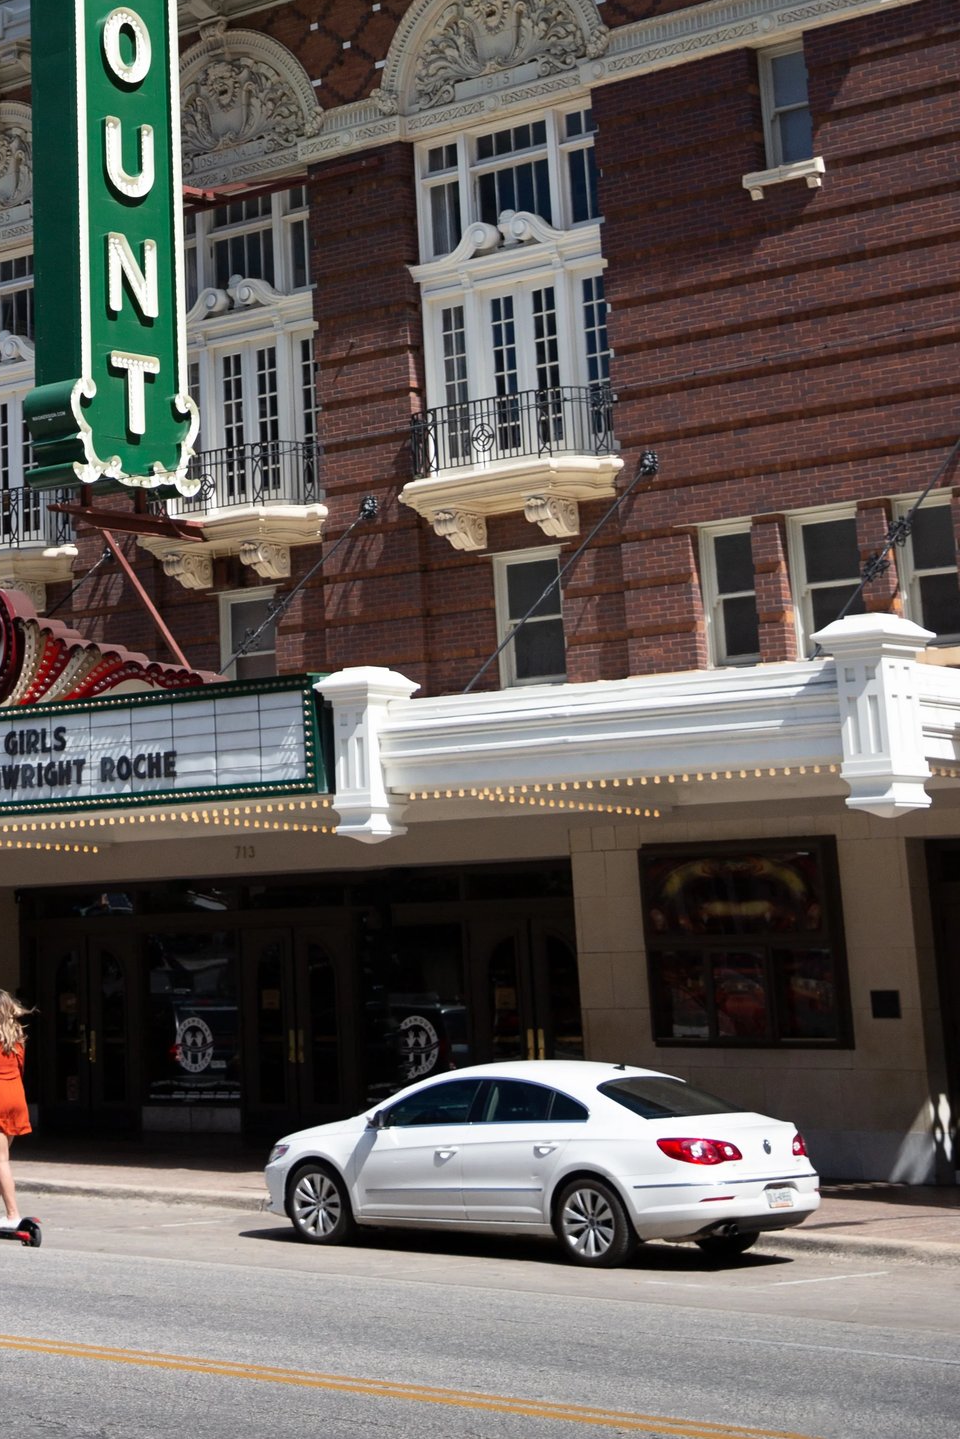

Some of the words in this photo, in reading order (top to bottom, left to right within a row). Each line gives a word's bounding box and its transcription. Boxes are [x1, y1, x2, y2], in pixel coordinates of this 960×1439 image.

[4, 726, 67, 756] GIRLS
[100, 750, 177, 783] ROCHE
[234, 845, 256, 859] 713
